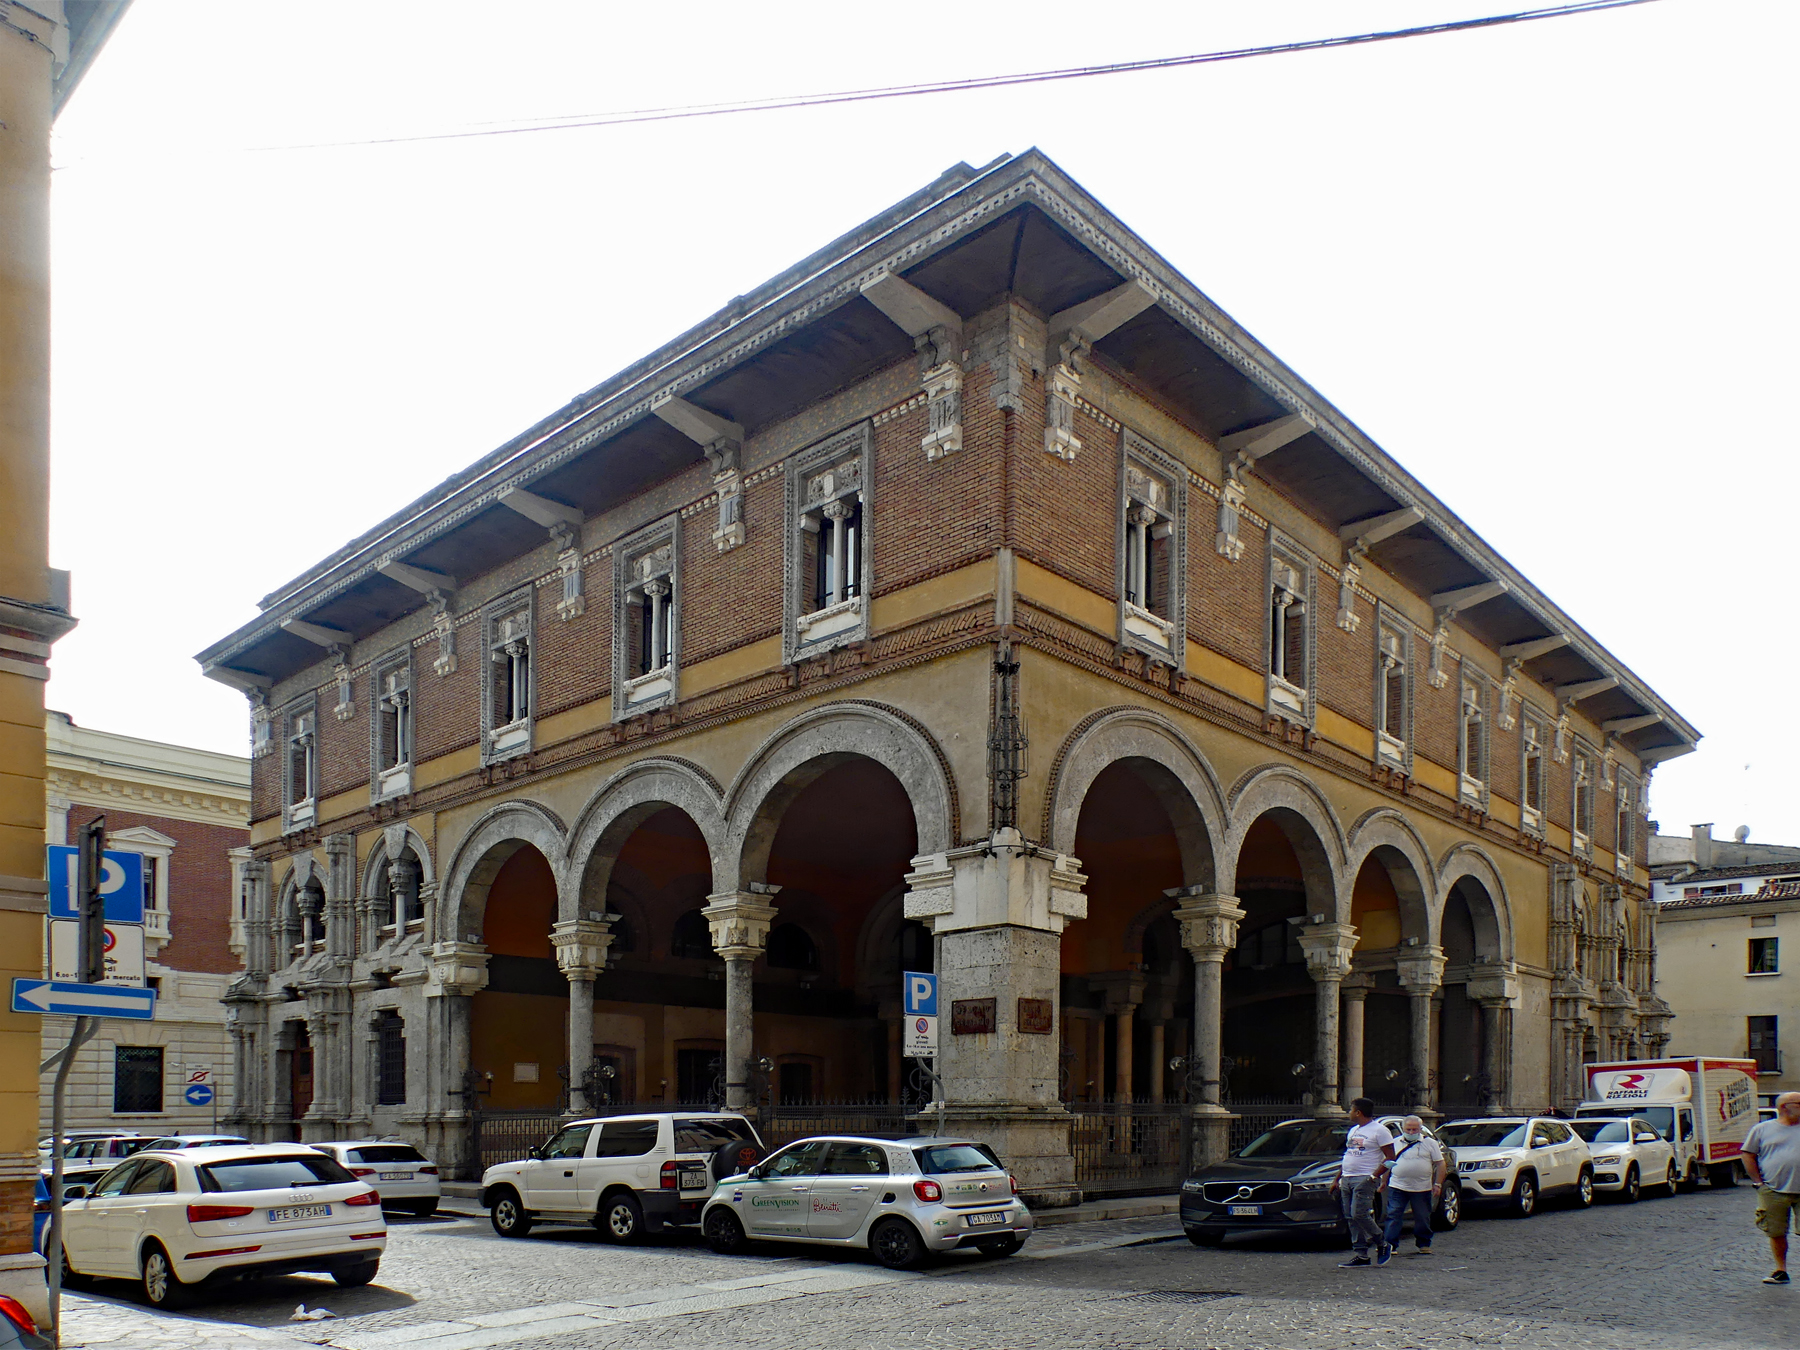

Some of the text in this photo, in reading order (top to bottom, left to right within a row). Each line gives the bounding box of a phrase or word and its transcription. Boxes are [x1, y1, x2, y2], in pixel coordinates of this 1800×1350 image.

[67, 854, 126, 911] P
[911, 976, 932, 1010] P
[690, 1172, 698, 1180] ZA
[696, 1179, 705, 1187] FM
[276, 1206, 326, 1219] FE 873AH
